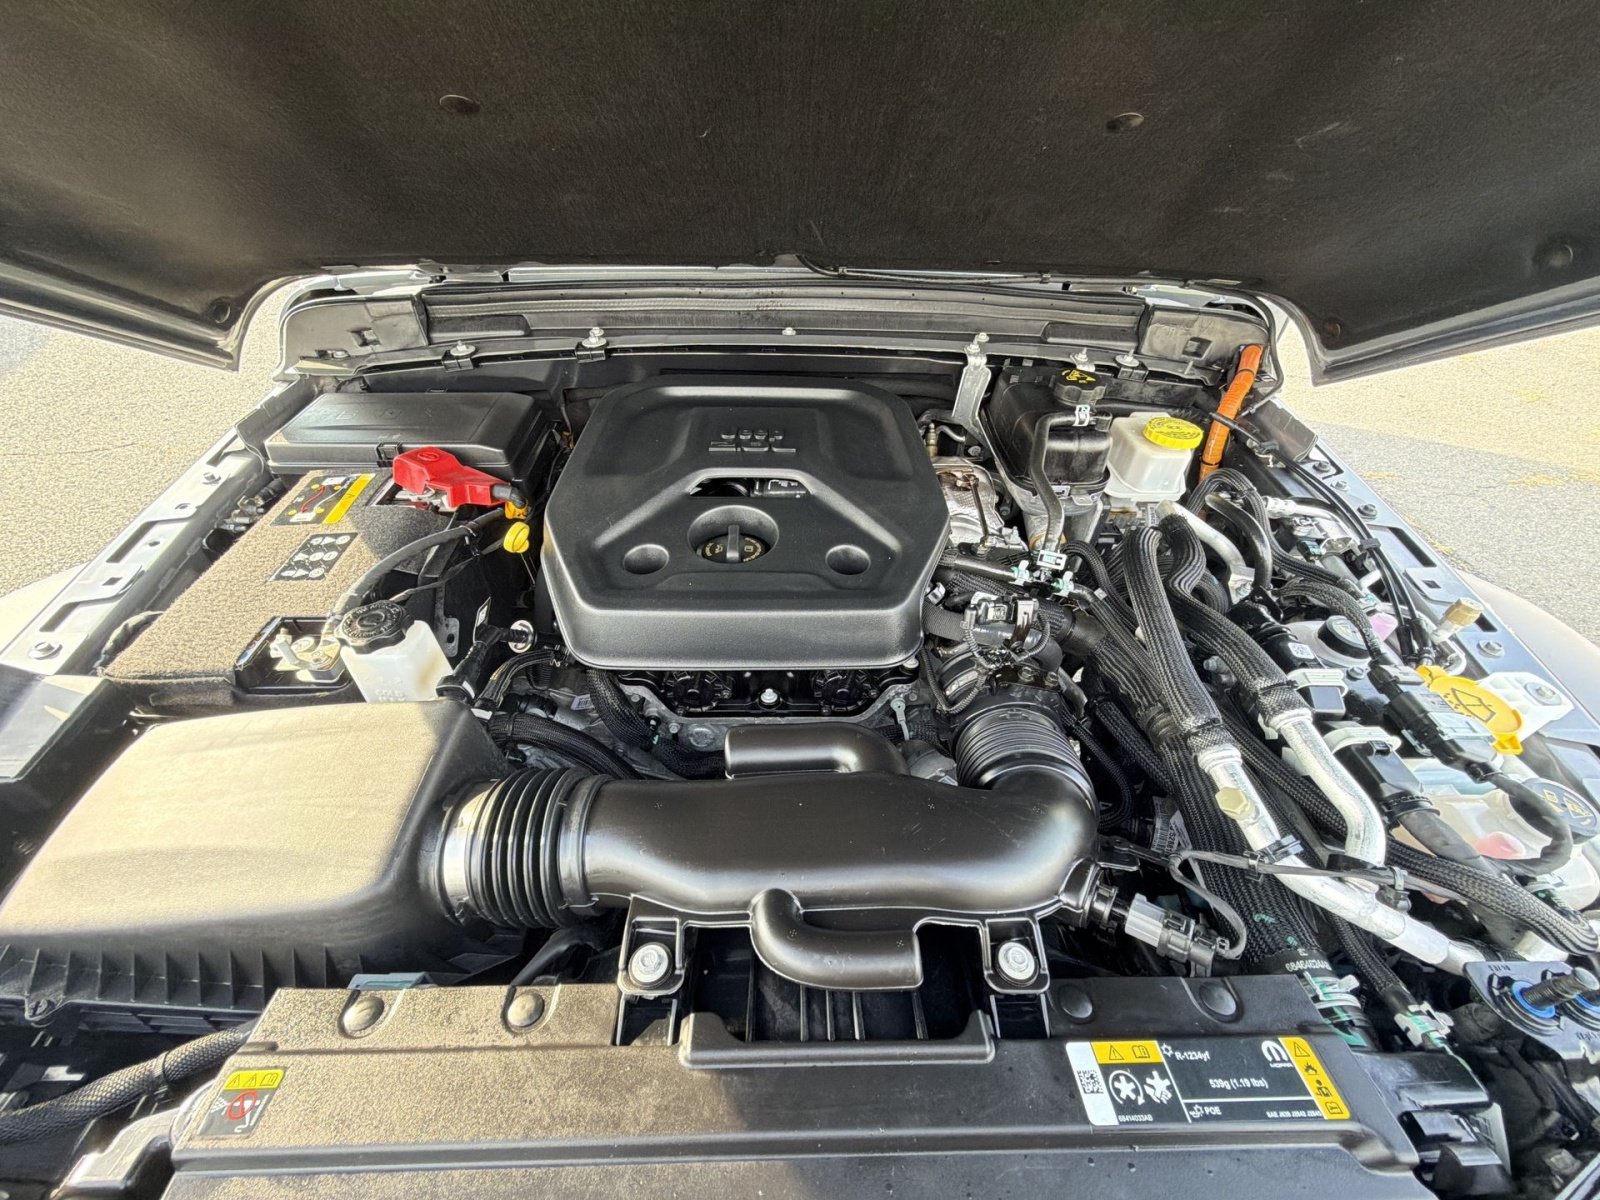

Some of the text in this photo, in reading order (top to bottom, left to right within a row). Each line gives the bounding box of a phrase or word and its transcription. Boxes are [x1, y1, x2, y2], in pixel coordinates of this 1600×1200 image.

[1175, 1051, 1210, 1061] R-1234yf
[1209, 1077, 1269, 1091] 539g (1.19 lbs)
[1204, 1106, 1221, 1115] POE
